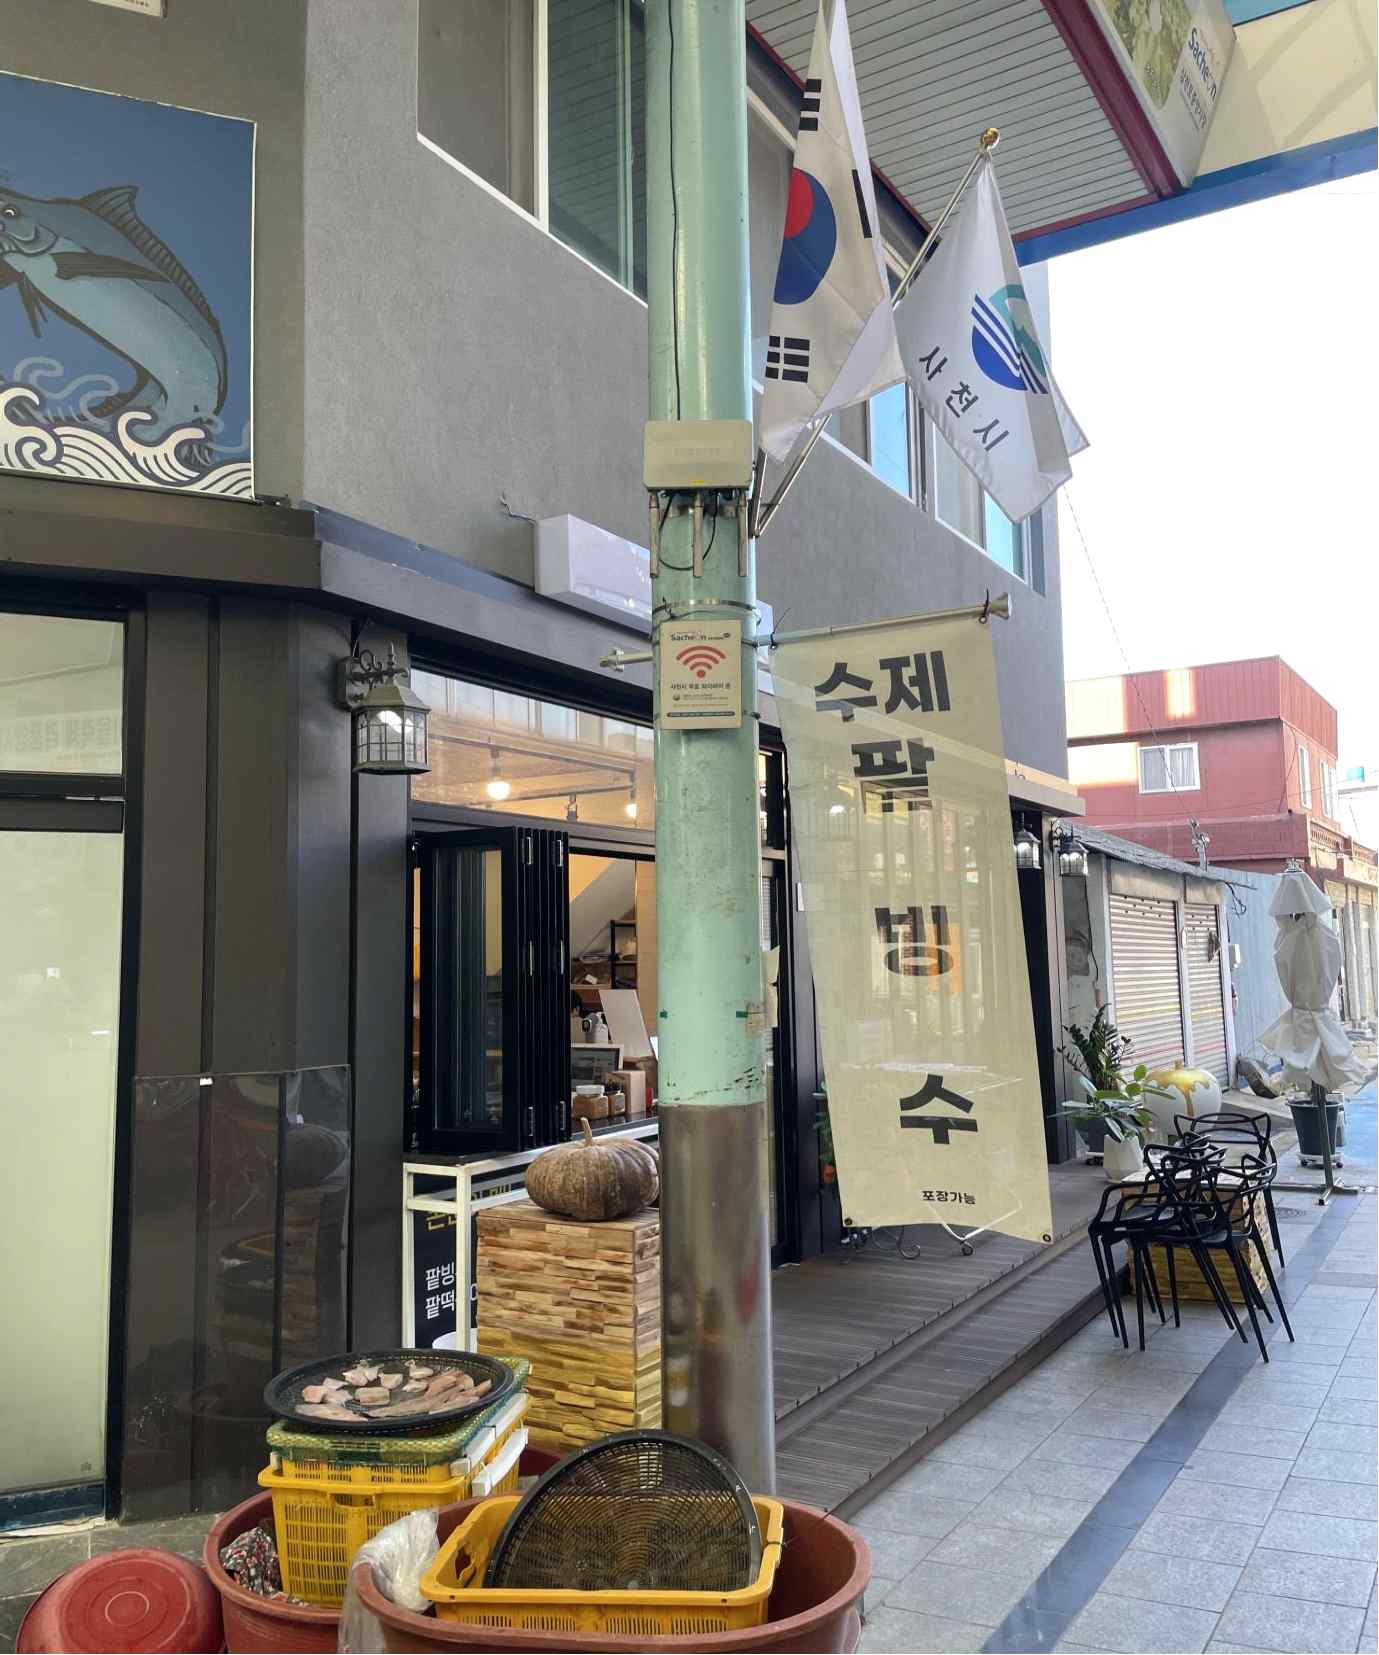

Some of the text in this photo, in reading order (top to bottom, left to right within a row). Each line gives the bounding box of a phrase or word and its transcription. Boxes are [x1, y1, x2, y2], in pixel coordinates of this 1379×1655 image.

[918, 345, 1009, 452] 사천시
[814, 650, 950, 722] 수제
[922, 1190, 976, 1205] 포장가능
